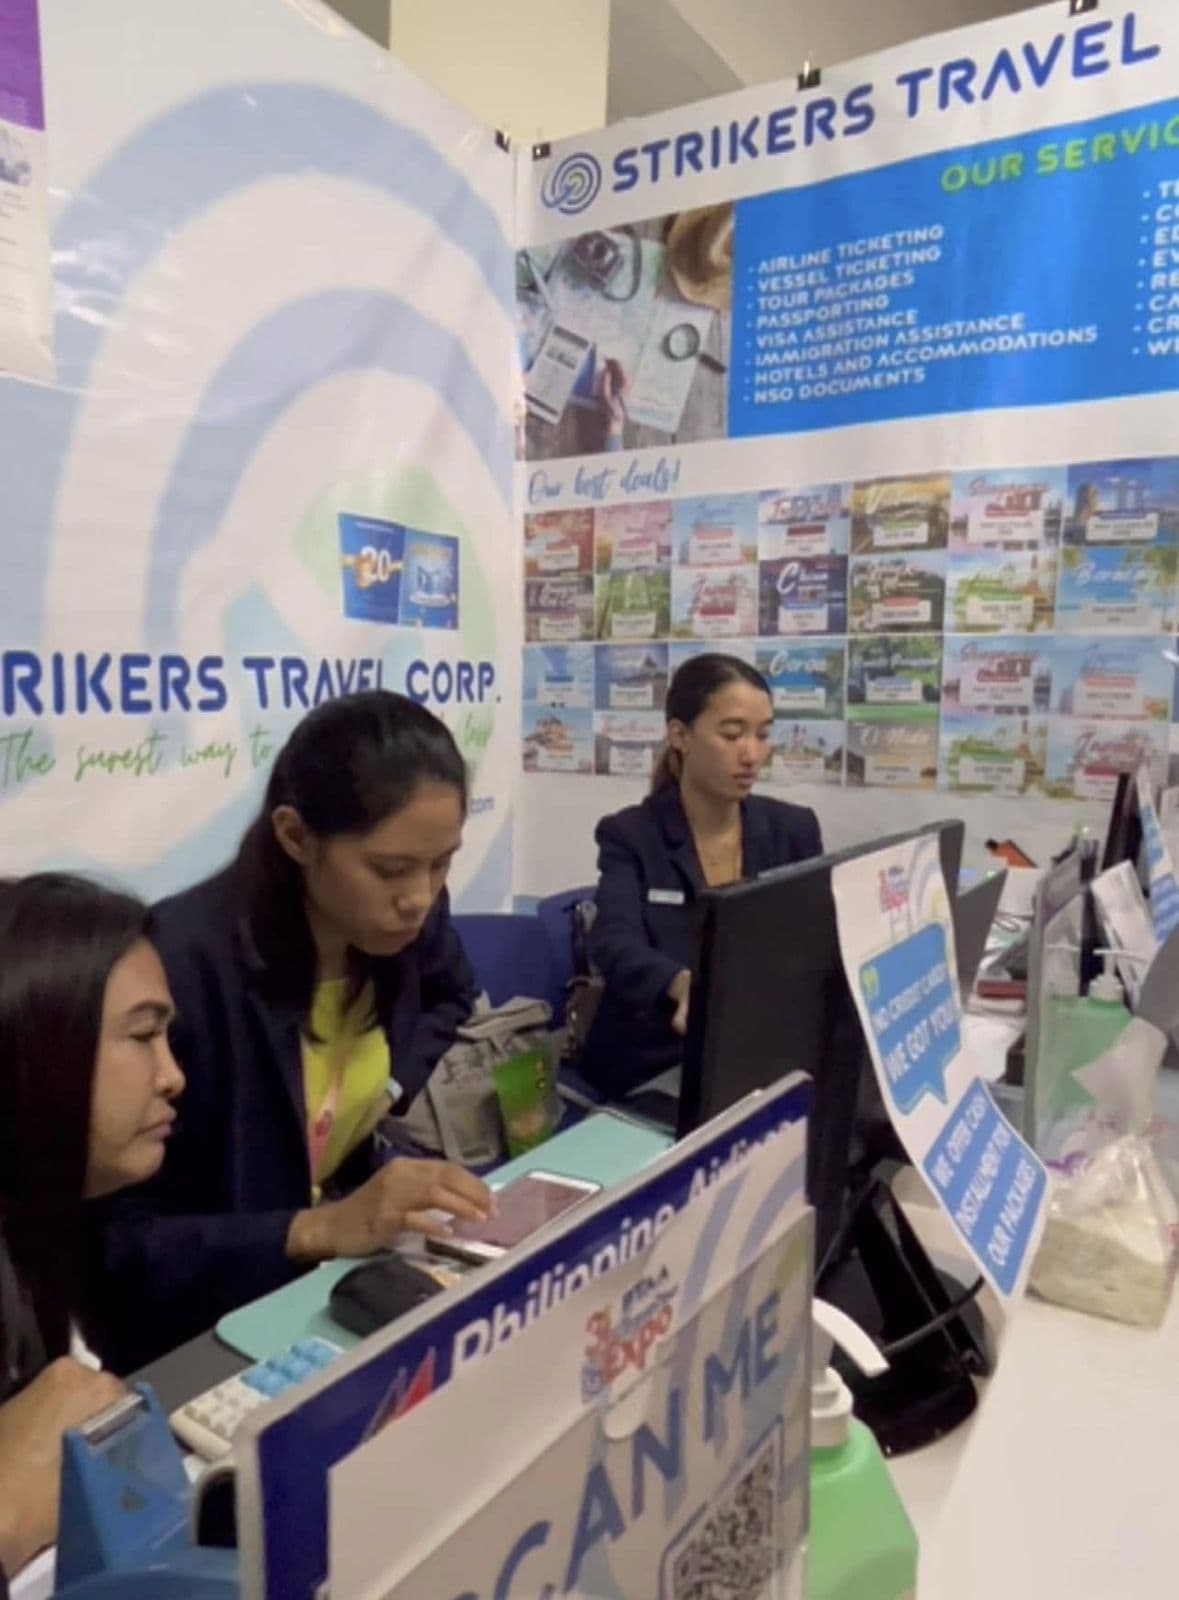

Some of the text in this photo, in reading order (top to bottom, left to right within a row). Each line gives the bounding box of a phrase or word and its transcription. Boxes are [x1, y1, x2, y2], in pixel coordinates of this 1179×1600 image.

[612, 12, 1161, 192] STRIKERS TRAVEL
[940, 151, 1023, 192] OUR
[758, 224, 944, 274] AIRLINE TICKETING
[758, 245, 942, 292] VESSEL TICKETING
[757, 294, 889, 329] PASSPORTING
[758, 270, 915, 311] TOUR PACKAGES
[756, 309, 918, 349] VISA ASSISTANCE
[756, 312, 1025, 367] IMMIGRATION ASSISTANCE
[755, 324, 1098, 386] HOTELS AND ACCOMMODATIONS
[754, 367, 926, 405] NSO DOCUMENTS
[528, 457, 680, 505] Our best deals!
[1, 650, 228, 716] RIKERS
[405, 659, 502, 704] CORP.
[0, 727, 57, 788] The
[75, 726, 169, 782] surest
[182, 740, 238, 778] way
[885, 1041, 910, 1084] WE
[905, 1018, 931, 1062] GOT
[452, 1291, 780, 1600] CAN ME
